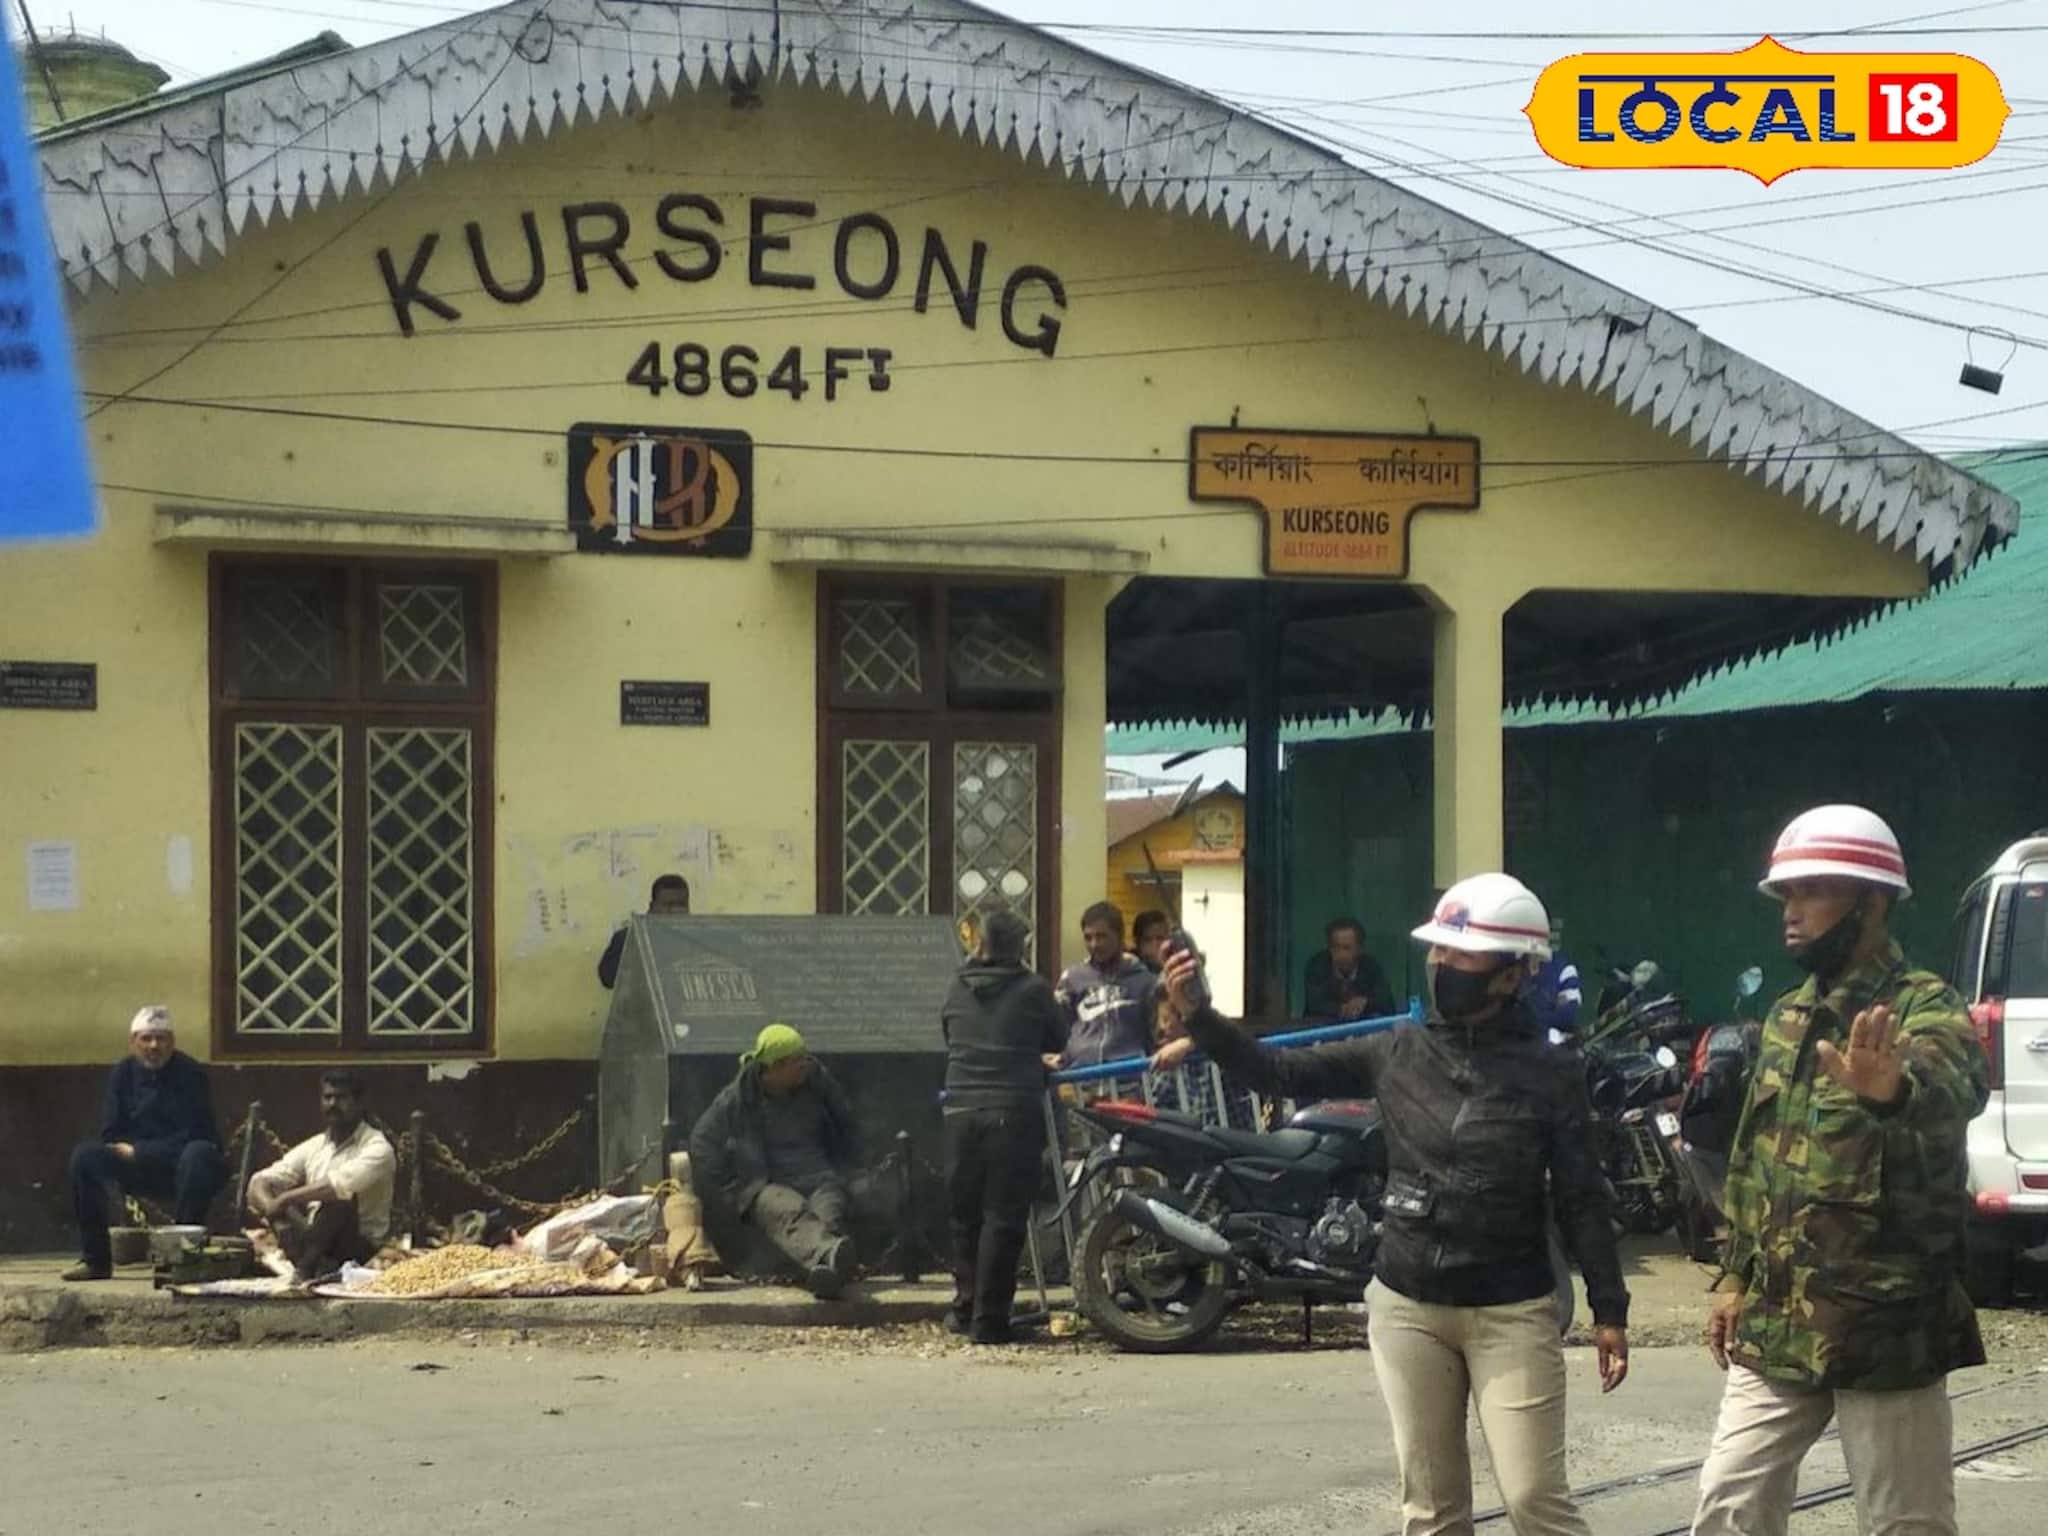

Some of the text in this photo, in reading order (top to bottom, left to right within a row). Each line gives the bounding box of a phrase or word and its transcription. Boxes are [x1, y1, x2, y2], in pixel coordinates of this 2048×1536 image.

[376, 193, 1067, 359] KURSEONG
[626, 341, 810, 402] 4864
[1358, 447, 1460, 486] कार्सियांग
[1282, 507, 1391, 536] KURSEONG
[679, 970, 760, 1003] UNESCO
